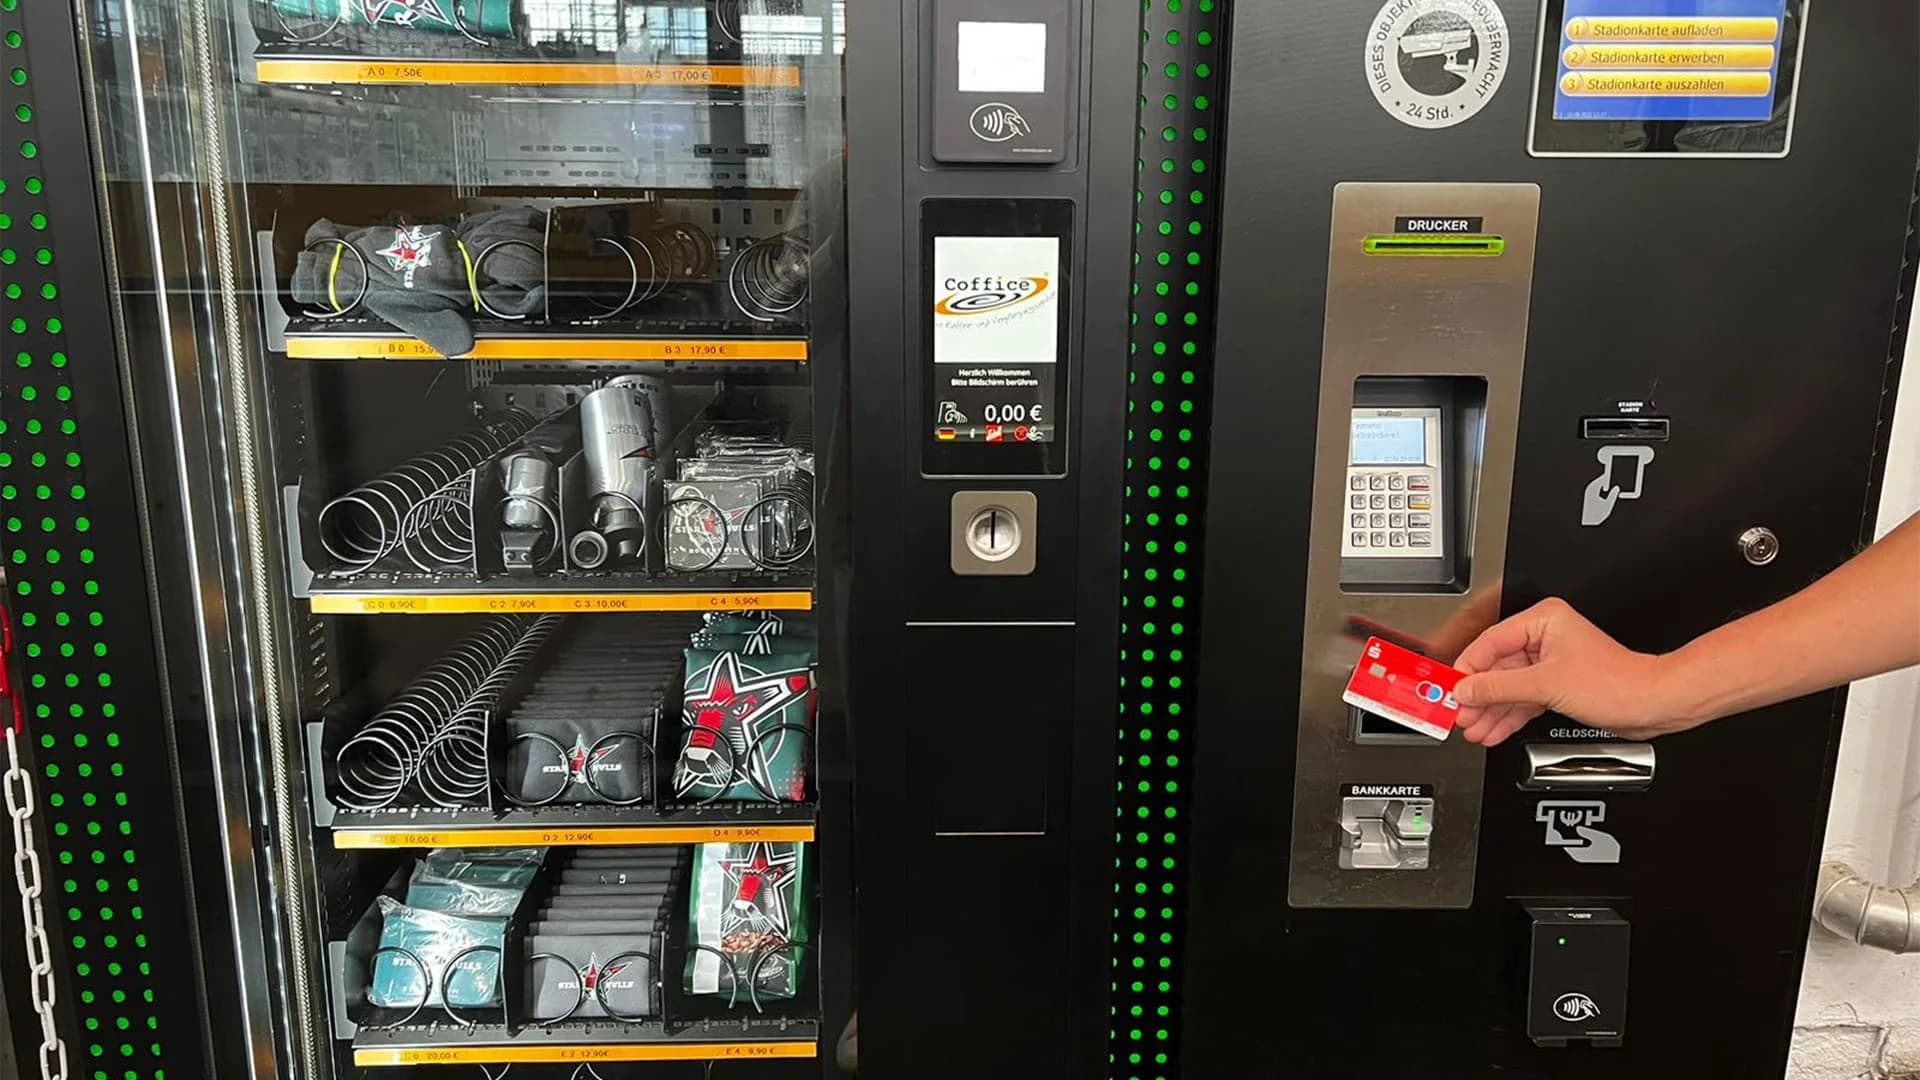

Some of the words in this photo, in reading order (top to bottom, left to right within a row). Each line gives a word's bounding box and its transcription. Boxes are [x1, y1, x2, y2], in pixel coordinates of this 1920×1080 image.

[1575, 25, 1581, 36] 1
[1594, 24, 1669, 36] Stadionkarte
[1672, 24, 1724, 36] aufladen
[1571, 51, 1578, 63] 2
[1591, 51, 1665, 63] Stadionkarte
[1669, 51, 1725, 63] erwerben
[368, 67, 376, 76] A
[1373, 44, 1392, 94] DIESES
[1568, 79, 1576, 90] 3
[1588, 78, 1663, 90] Stadionkarte
[1666, 78, 1724, 90] auszahlen
[1406, 102, 1423, 119] 24
[1426, 105, 1455, 120] Std.
[1408, 219, 1469, 231] DRUCKER
[944, 276, 1030, 291] Coffice
[958, 368, 987, 377] Herzlich
[987, 368, 1031, 377] Willkommen
[968, 378, 1005, 386] Bildschirm
[1005, 378, 1039, 386] berühren
[984, 404, 1025, 424] 0,00
[1029, 404, 1043, 421] €
[1549, 728, 1617, 738] GELDSCHE
[1352, 786, 1421, 795] BANKKARTE
